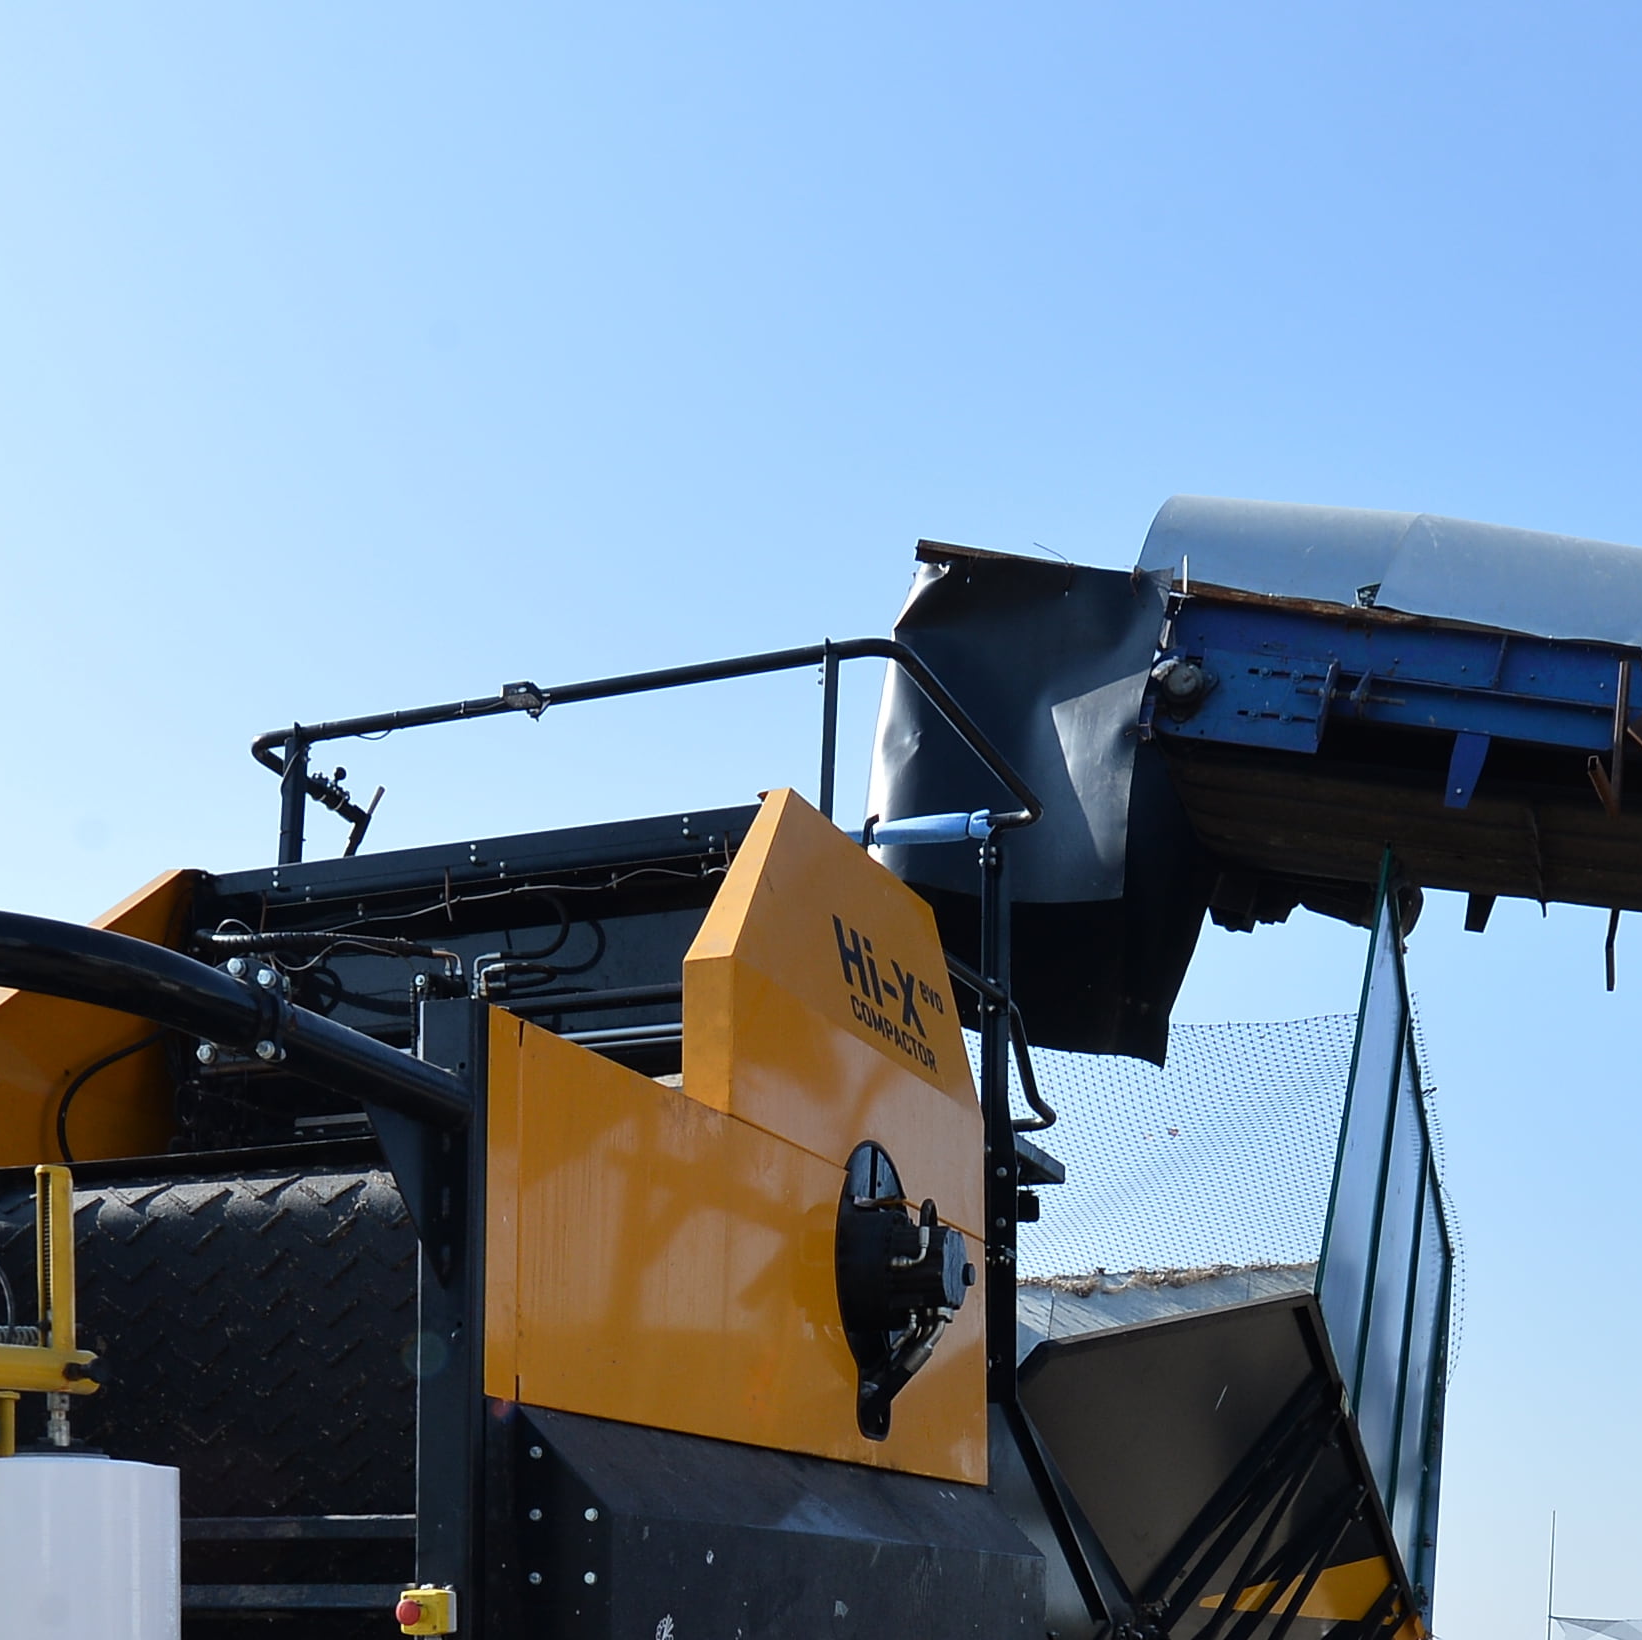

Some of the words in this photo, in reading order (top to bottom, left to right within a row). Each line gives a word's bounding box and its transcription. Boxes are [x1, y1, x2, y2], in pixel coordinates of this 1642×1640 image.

[832, 914, 926, 1039] Hi-X
[920, 981, 944, 1014] evo
[851, 996, 938, 1073] COMPACTOR
